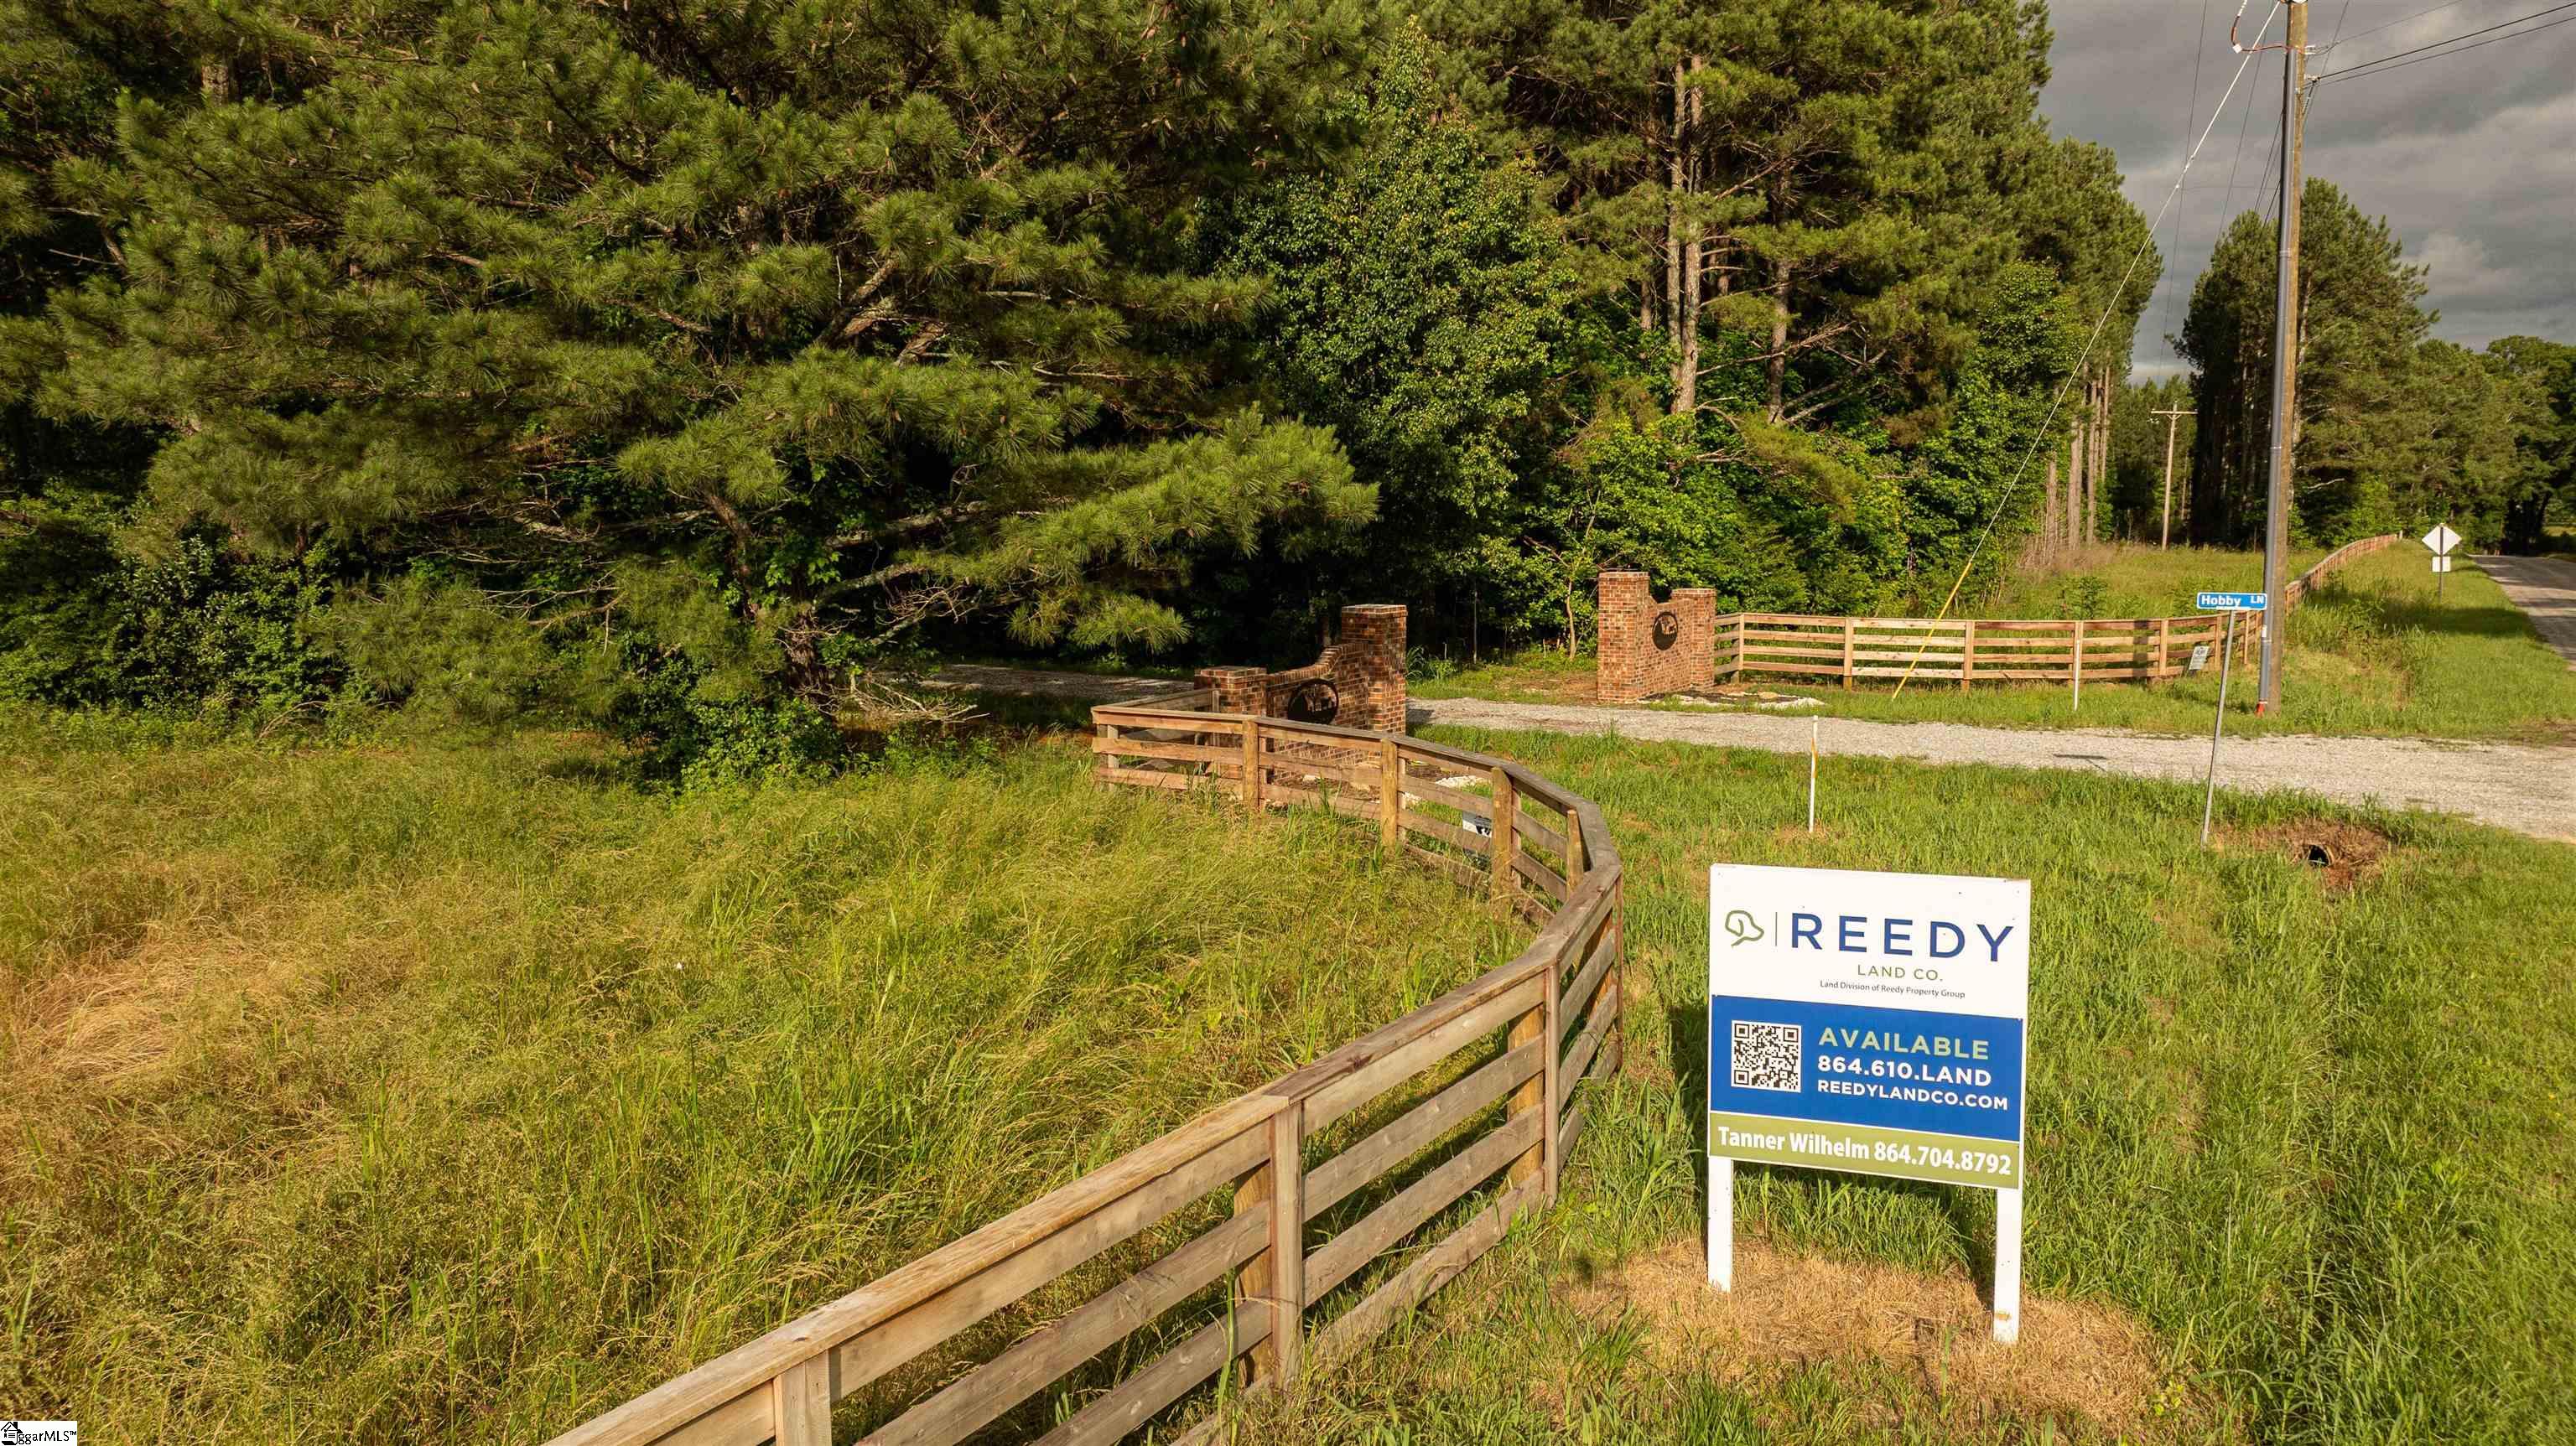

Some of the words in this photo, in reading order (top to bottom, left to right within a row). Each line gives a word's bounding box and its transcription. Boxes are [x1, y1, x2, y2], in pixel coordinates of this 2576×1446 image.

[2201, 595, 2241, 607] Hobby
[2250, 595, 2264, 604] LN
[1791, 912, 2014, 962] REEDY
[1857, 964, 1906, 979] LAND
[1914, 968, 1944, 982] CO.
[1820, 980, 1839, 990] Land
[1840, 982, 1870, 993] Division
[1871, 982, 1880, 993] of
[1881, 984, 1904, 996] Reedy
[1906, 986, 1940, 998] Property
[1940, 988, 1966, 999] Group
[1818, 1027, 1989, 1060] AVAILABLE
[1818, 1055, 1992, 1087] 864.610.LAND
[1818, 1080, 2008, 1111] REEDYLANDCO.COM
[1718, 1126, 1784, 1151] Tanner
[1790, 1132, 1869, 1159] Wilhelm
[1874, 1143, 2012, 1176] 864.704.8792
